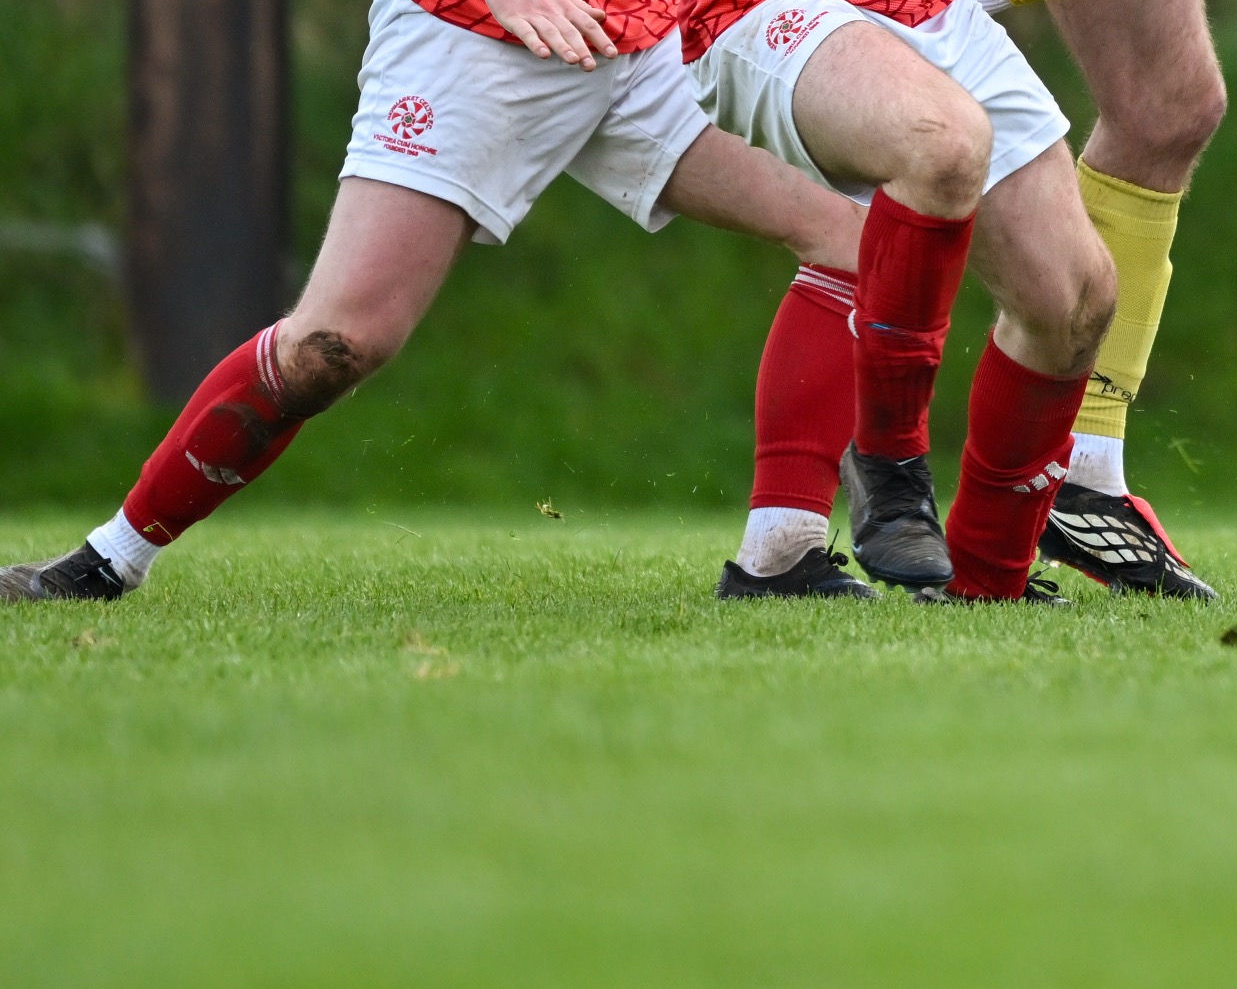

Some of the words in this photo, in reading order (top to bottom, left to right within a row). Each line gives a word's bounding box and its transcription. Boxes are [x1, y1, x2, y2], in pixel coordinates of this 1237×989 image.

[419, 98, 434, 119] CELTIC
[373, 133, 397, 144] VICTORIA
[397, 140, 411, 148] CUM
[411, 142, 438, 155] HONORE
